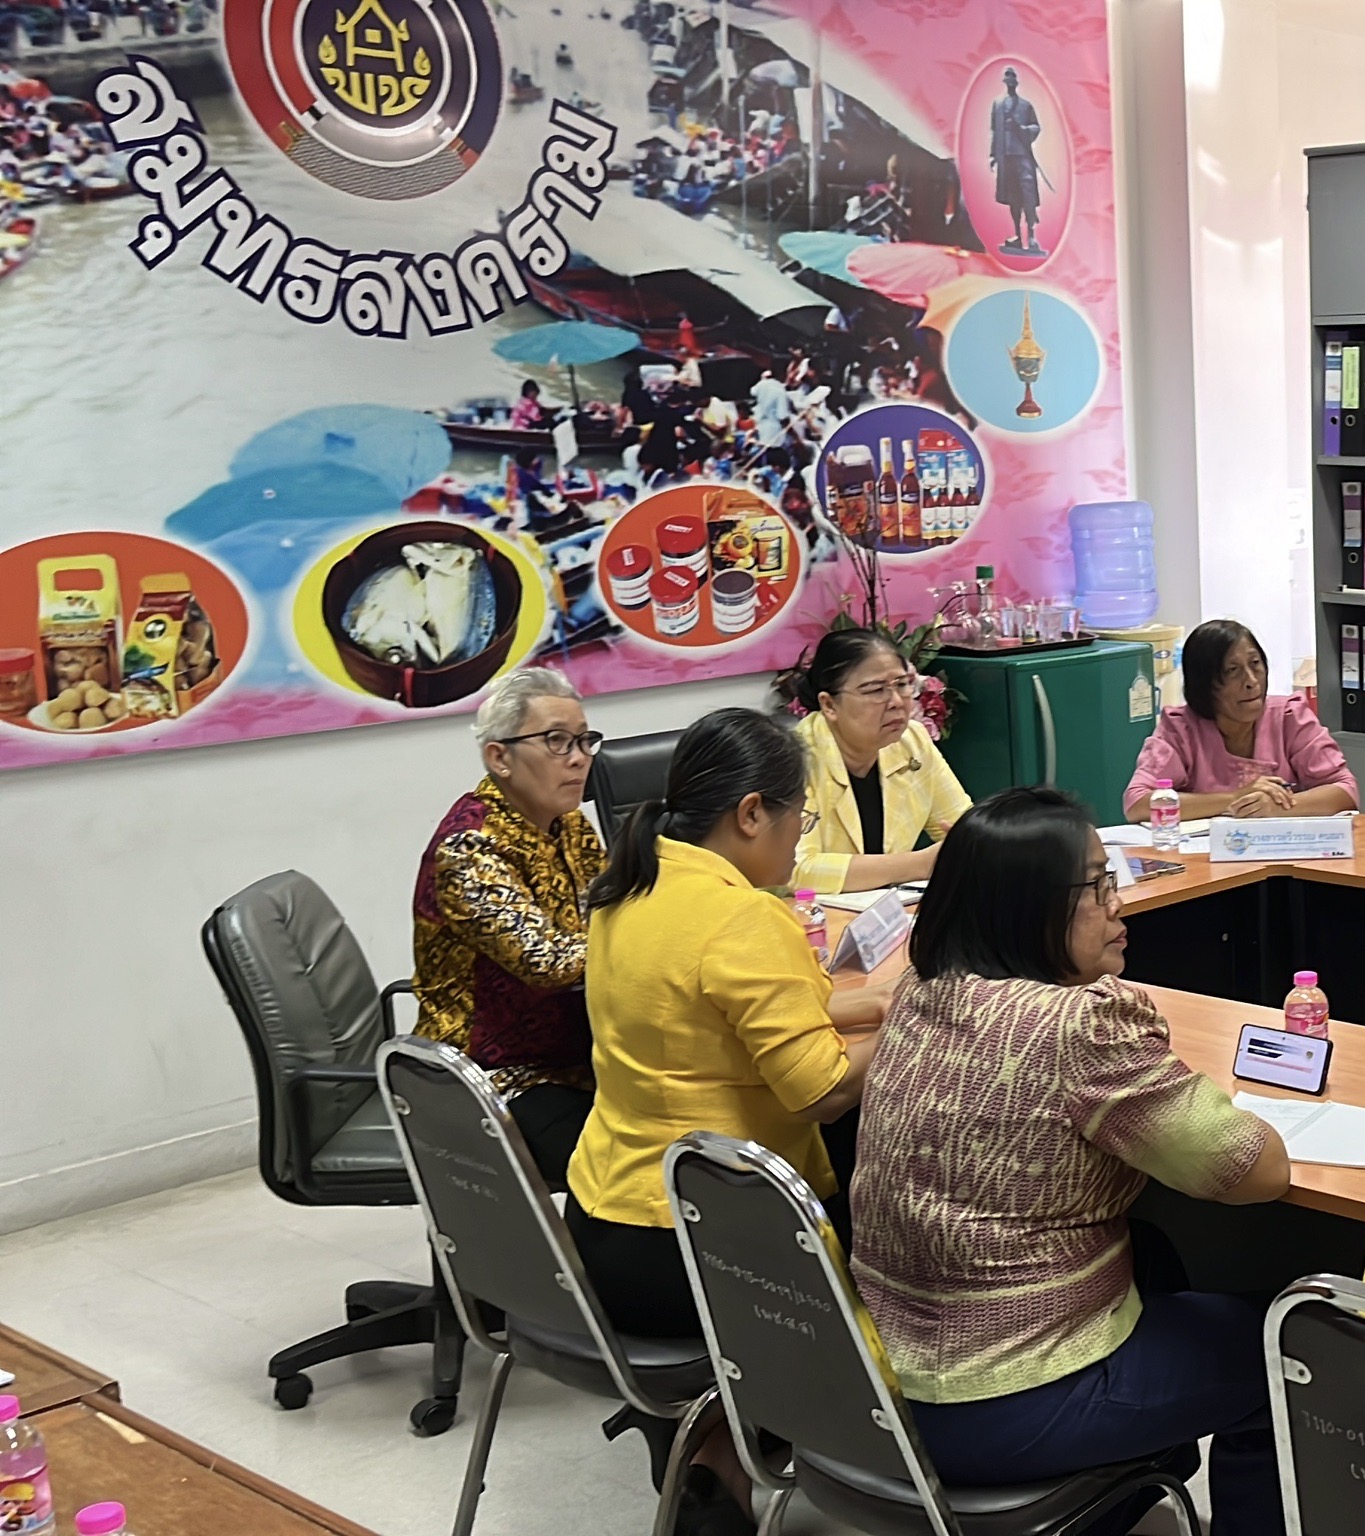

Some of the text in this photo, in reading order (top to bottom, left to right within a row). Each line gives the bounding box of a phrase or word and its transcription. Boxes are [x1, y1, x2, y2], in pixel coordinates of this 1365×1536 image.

[95, 54, 618, 338] สมุทรสงคราม
